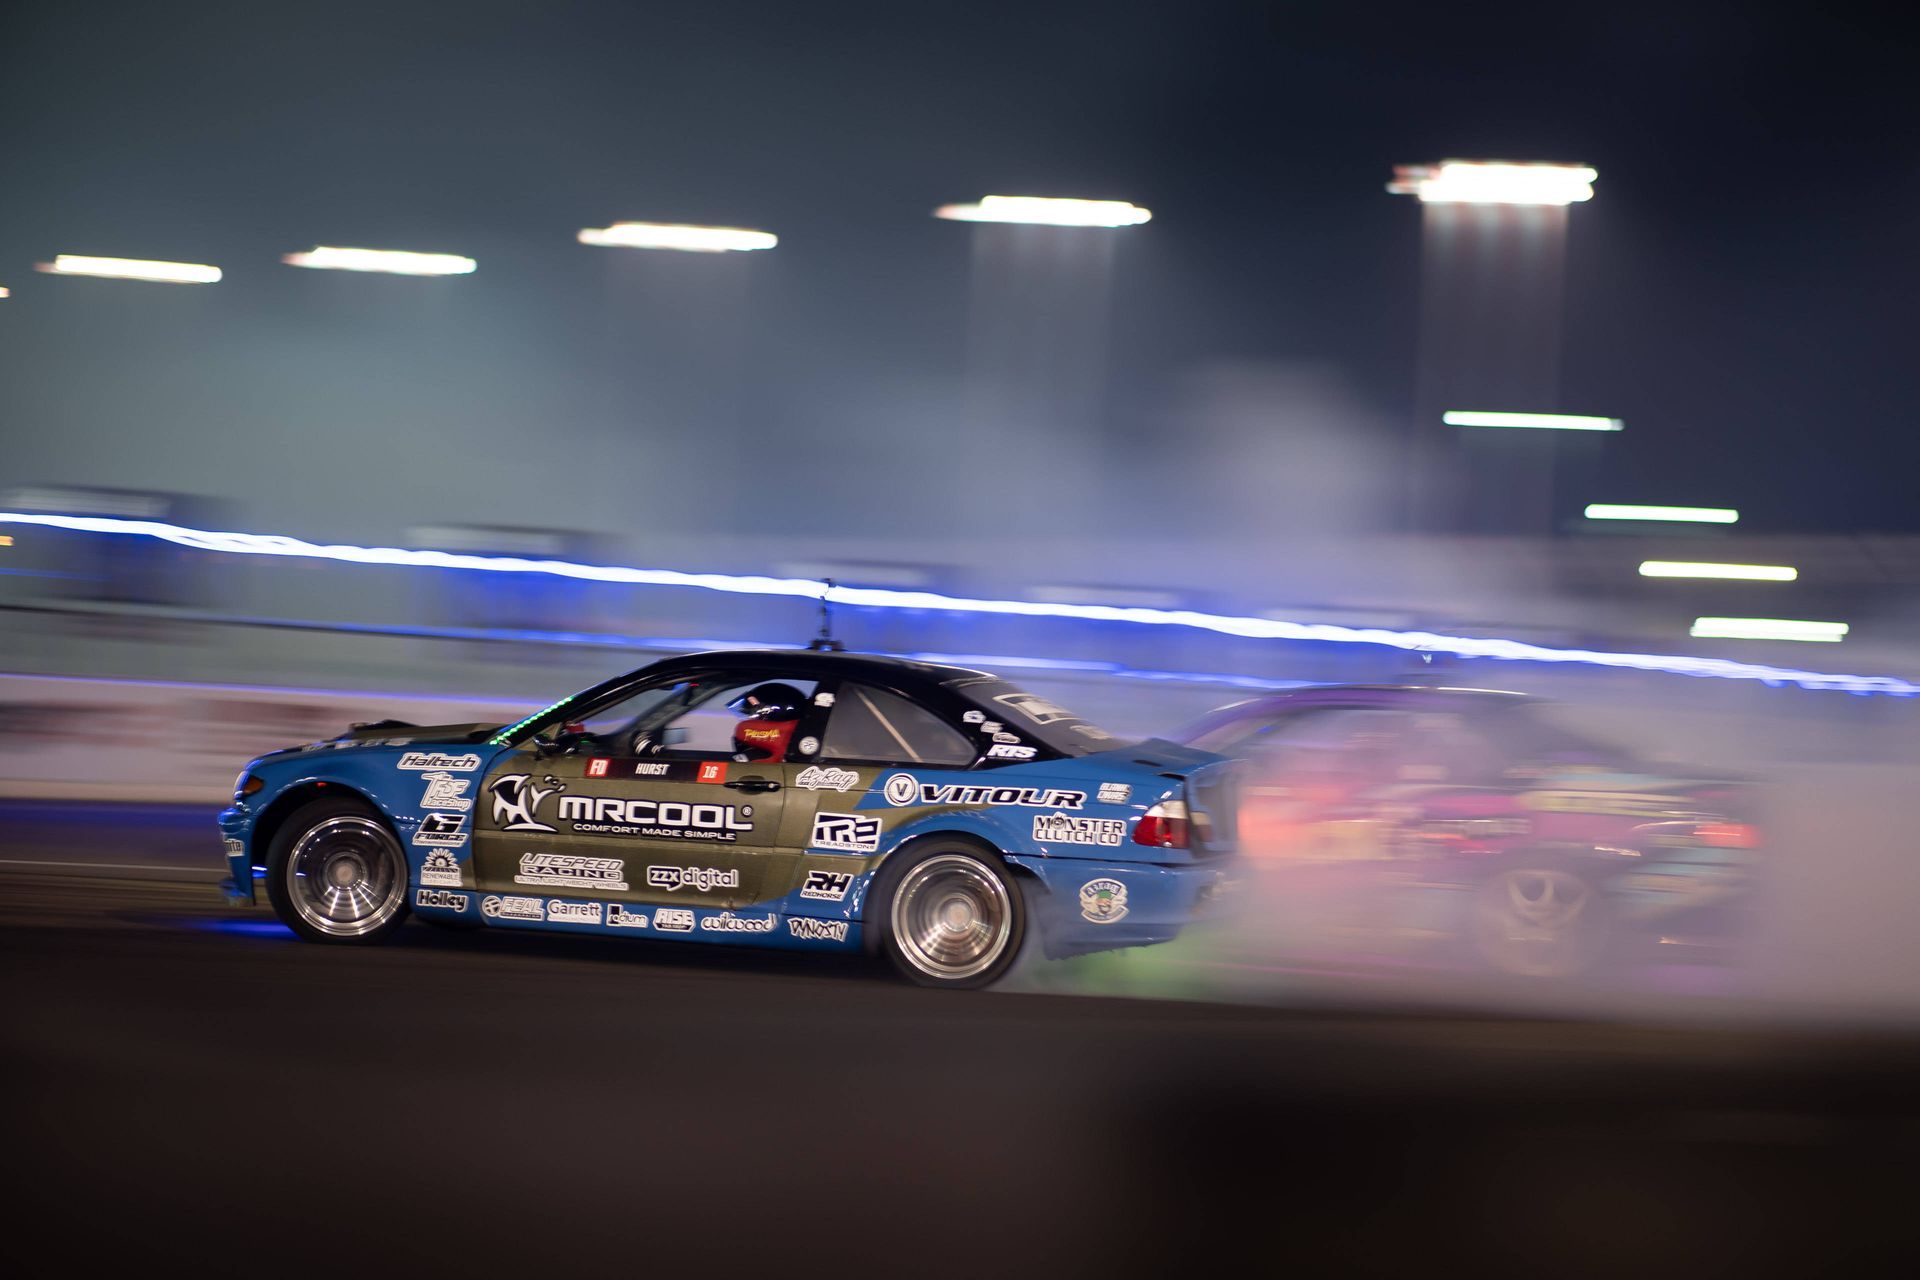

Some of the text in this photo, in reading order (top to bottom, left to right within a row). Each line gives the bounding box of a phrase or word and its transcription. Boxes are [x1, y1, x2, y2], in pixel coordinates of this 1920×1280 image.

[400, 754, 478, 769] Haltech
[589, 759, 608, 775] FD
[635, 762, 669, 776] HURST
[702, 765, 718, 779] 16
[921, 785, 1085, 808] VITOUR
[558, 796, 753, 831] MRCOOL
[572, 822, 736, 841] COMFORT MADE SIMPLE
[1036, 816, 1123, 834] MONSTER
[414, 833, 465, 842] FORCE
[1035, 829, 1119, 844] CLUTCH CO
[815, 840, 875, 850] TREADSTONE
[521, 854, 622, 871] LITESPEED
[421, 871, 460, 881] RENEWABLE
[525, 865, 620, 879] RACING
[806, 872, 852, 893] RH
[419, 890, 466, 911] Holley
[801, 891, 842, 900] REDHORSE
[501, 898, 545, 913] FEAL
[548, 900, 600, 916] Garrett
[656, 910, 692, 925] RISE
[702, 912, 777, 931] wilwood
